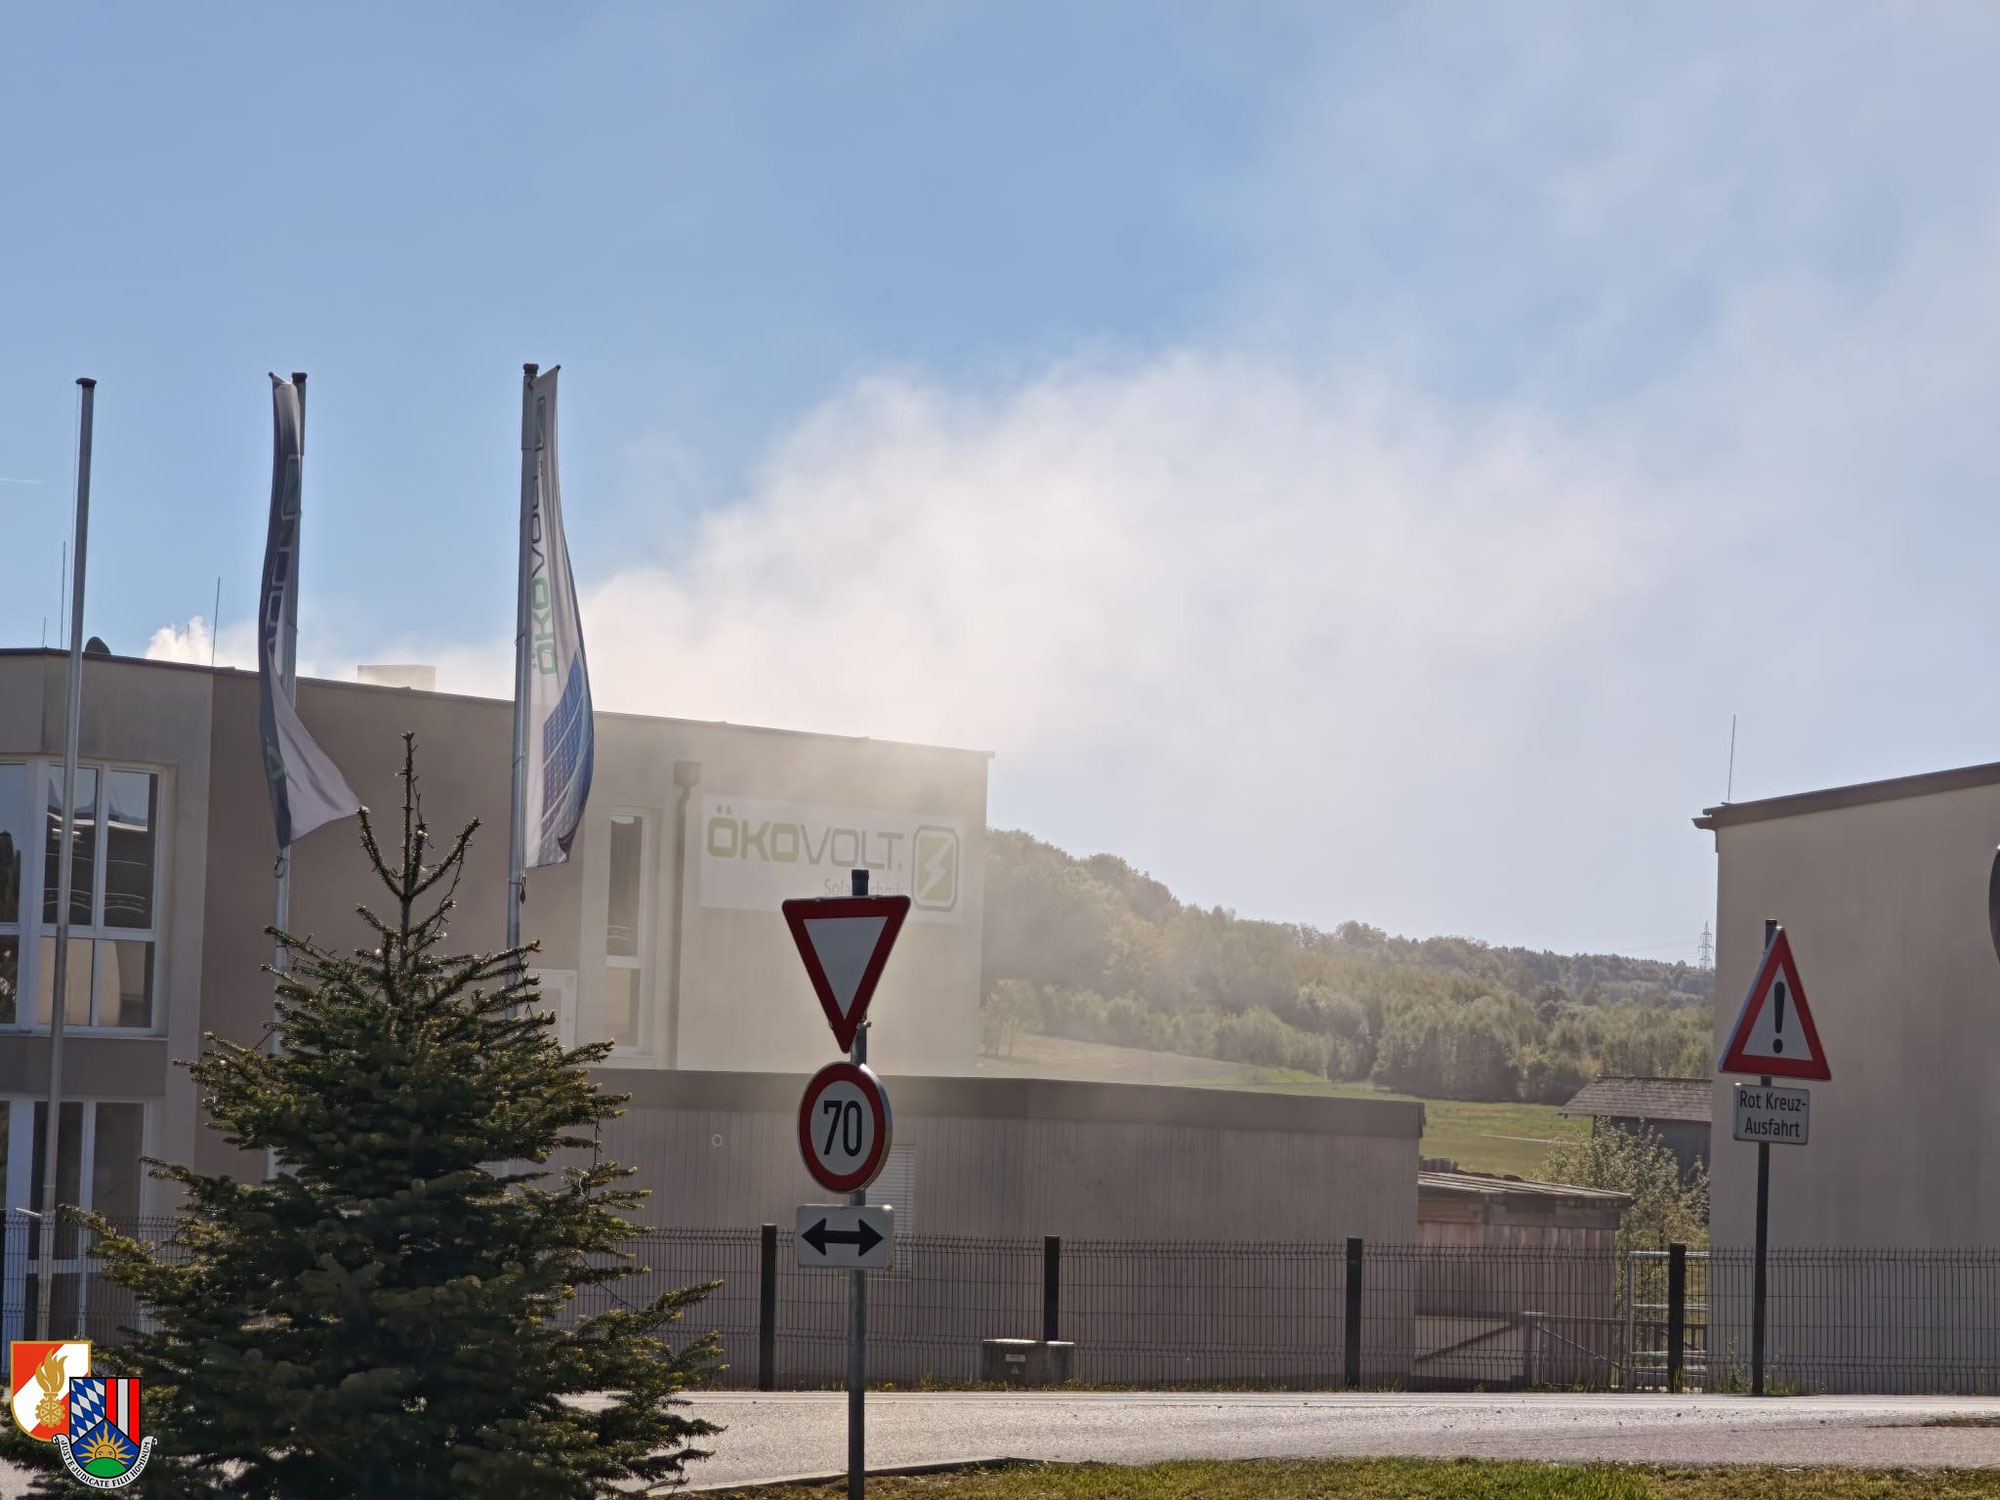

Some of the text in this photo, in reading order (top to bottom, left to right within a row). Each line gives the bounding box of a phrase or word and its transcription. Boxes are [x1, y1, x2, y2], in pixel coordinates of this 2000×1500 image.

[1740, 1090, 1807, 1112] Rot Kreuz-
[823, 1100, 862, 1157] 70
[1745, 1117, 1800, 1137] Ausfahrt
